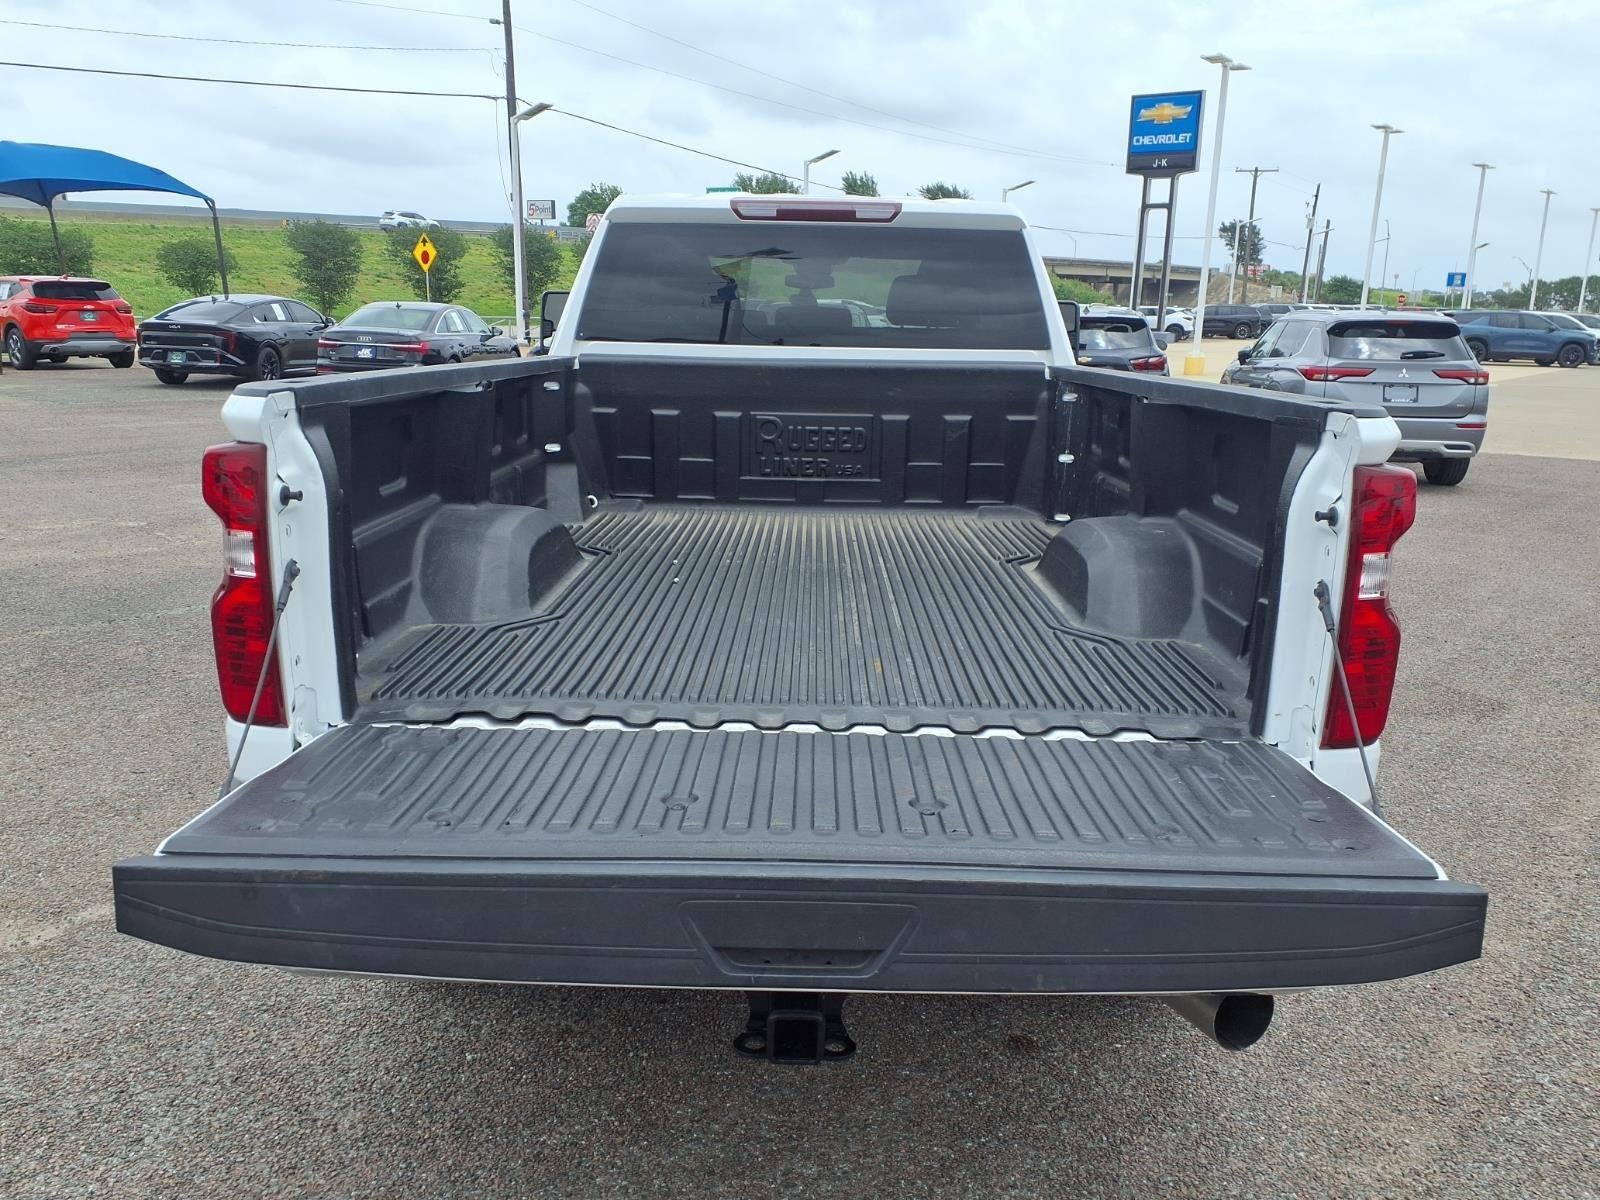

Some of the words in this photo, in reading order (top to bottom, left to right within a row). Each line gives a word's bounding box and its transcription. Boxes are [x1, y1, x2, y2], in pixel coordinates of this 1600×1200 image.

[1133, 133, 1192, 146] CHEVROLET
[755, 415, 866, 454] RUGGED
[760, 456, 831, 476] LINER
[835, 464, 863, 476] USA
